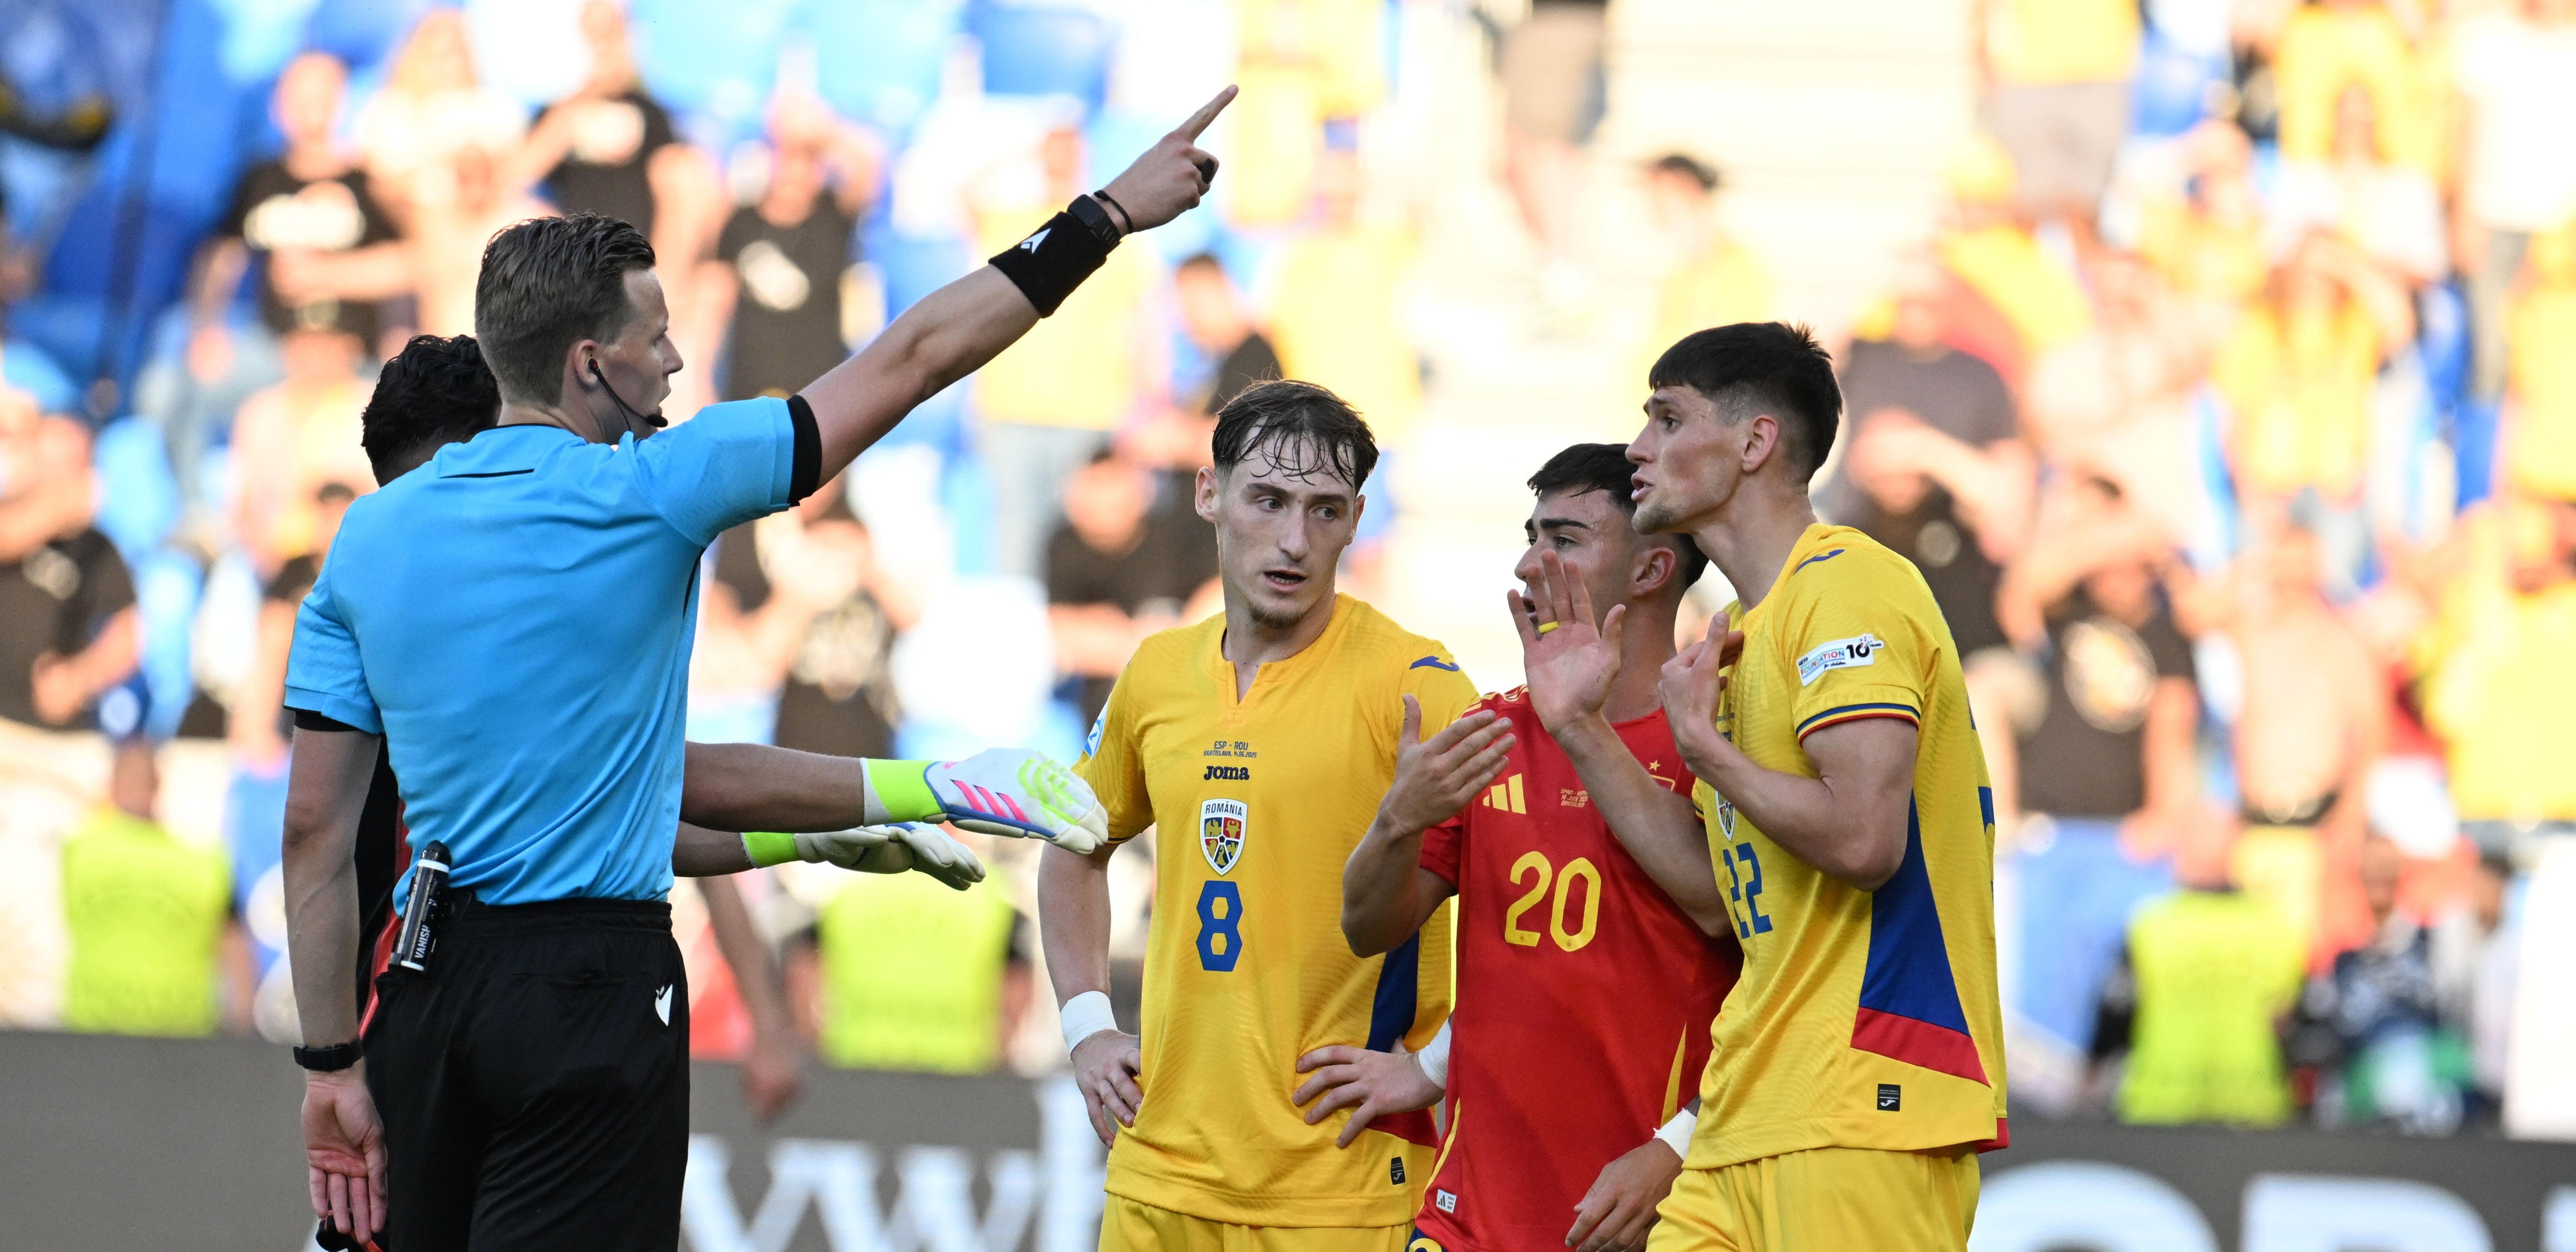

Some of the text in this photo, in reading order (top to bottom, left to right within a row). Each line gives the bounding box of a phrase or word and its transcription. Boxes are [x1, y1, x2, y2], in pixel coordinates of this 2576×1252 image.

[1798, 657, 1808, 666] UEFA
[1800, 650, 1845, 676] FOUNDATION
[1846, 642, 1870, 658] 10
[1214, 741, 1227, 750] ESP
[1234, 741, 1249, 750] ROU
[1205, 801, 1242, 817] ROMÂNIA
[1505, 851, 1602, 952] 20
[1722, 842, 1773, 939] 22
[1196, 880, 1243, 972] 8
[414, 925, 431, 958] VANISH
